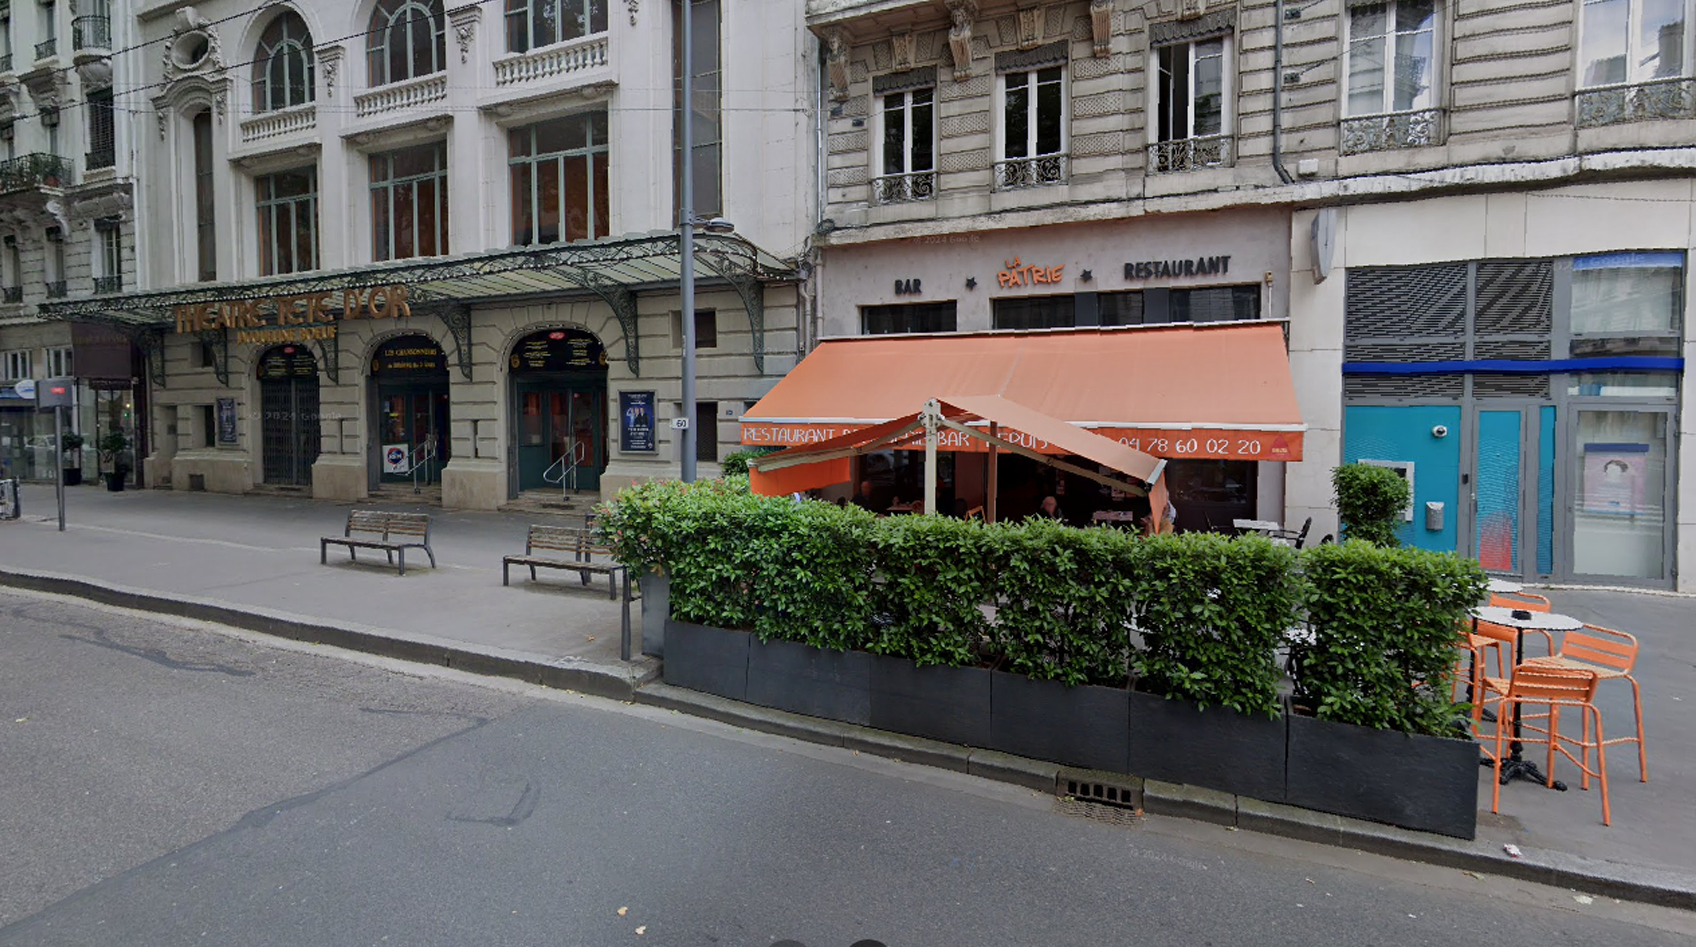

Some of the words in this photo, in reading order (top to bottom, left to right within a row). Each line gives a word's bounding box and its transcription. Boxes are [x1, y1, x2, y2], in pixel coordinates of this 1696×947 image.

[1005, 256, 1021, 269] LA
[1124, 255, 1231, 280] RESTAURANT
[997, 263, 1065, 288] PATRIE
[895, 278, 923, 296] BAR
[173, 299, 266, 334] THEATRE
[275, 291, 335, 326] TETE
[343, 284, 411, 321] D'OR
[744, 427, 835, 443] RESTAURANT
[937, 431, 969, 447] BAR
[1147, 438, 1168, 452] 78
[1176, 438, 1198, 454] 60
[1206, 439, 1229, 455] 02
[1238, 440, 1261, 455] 20
